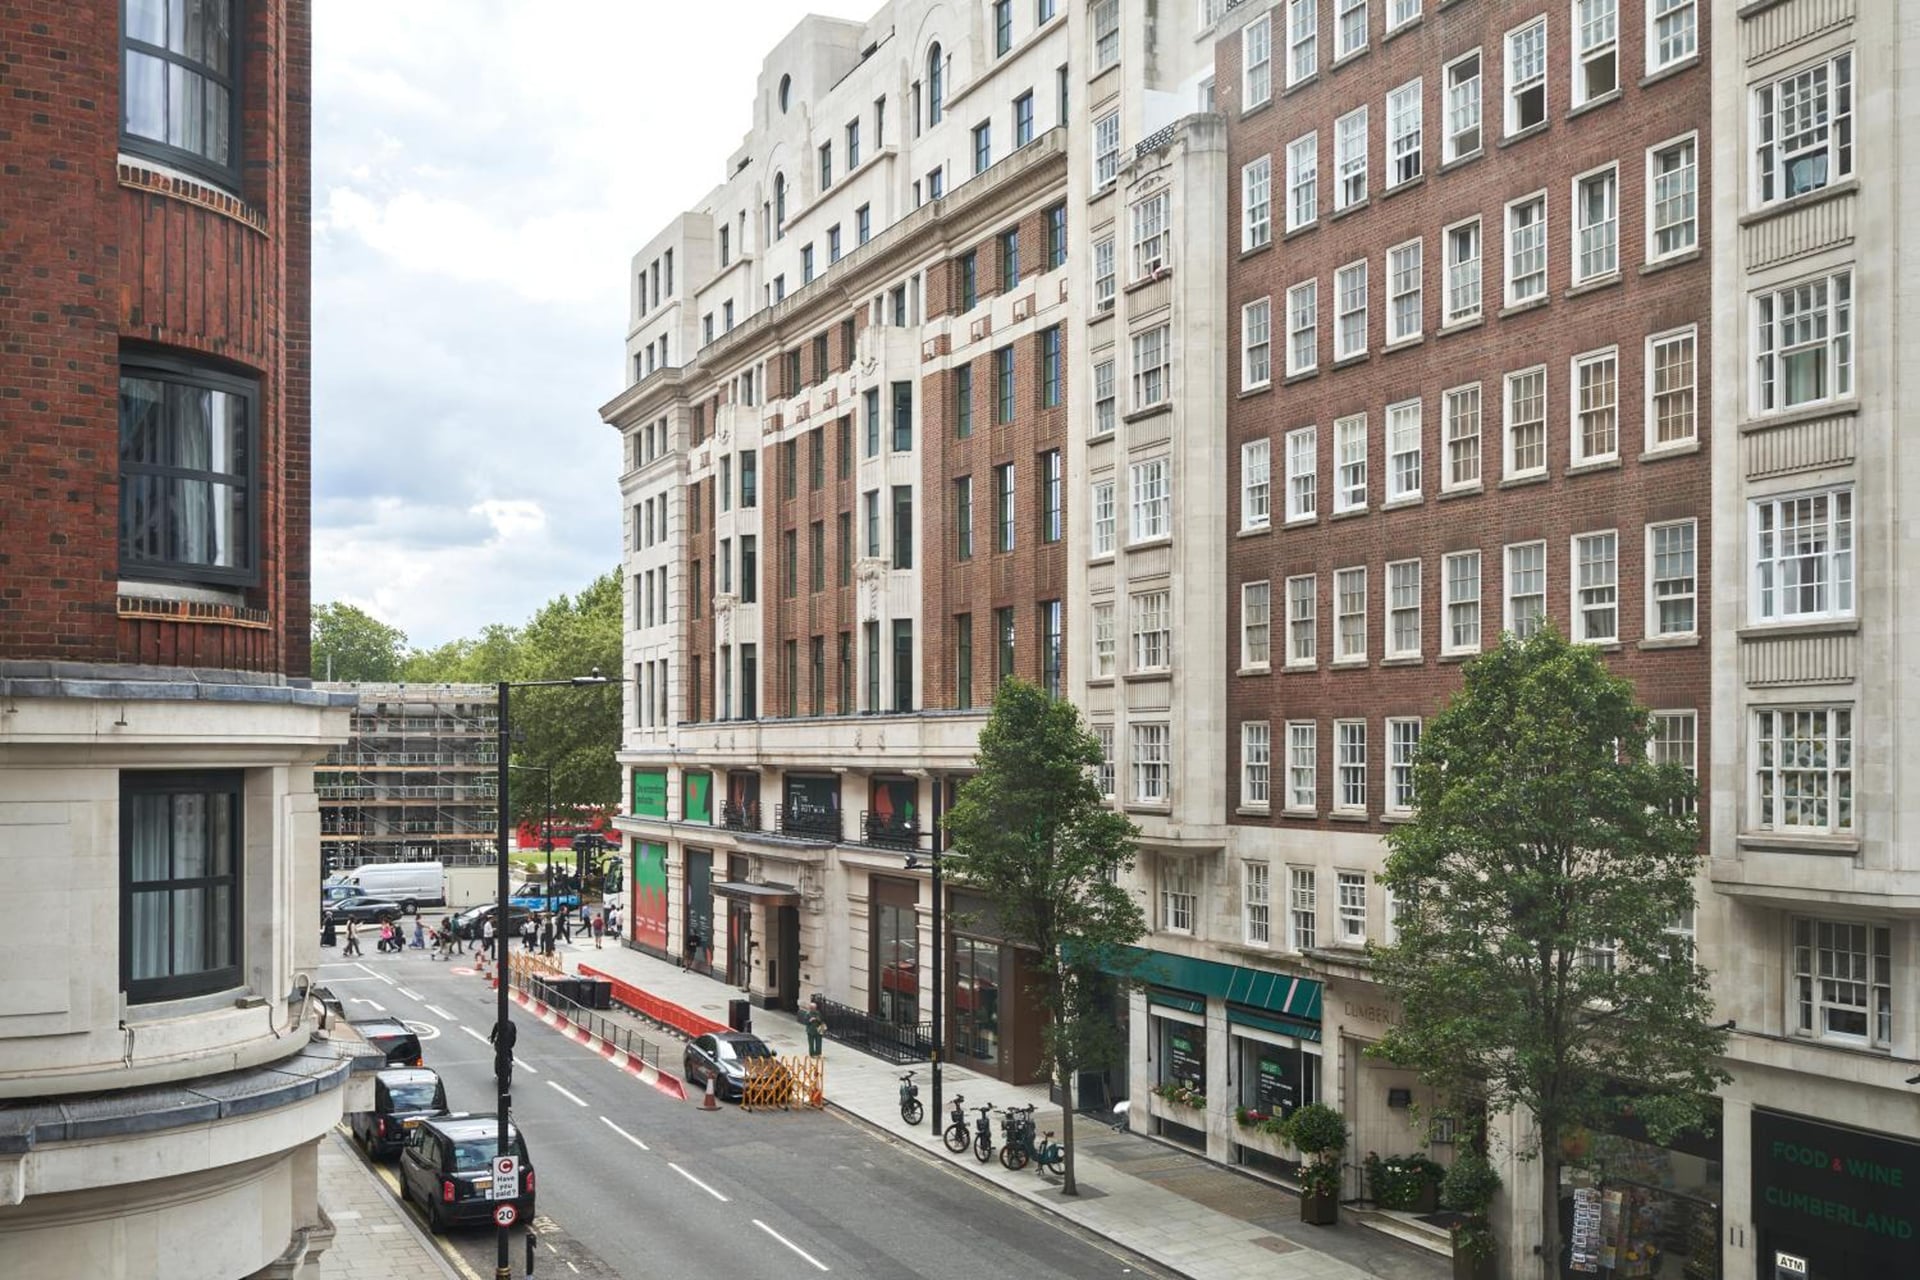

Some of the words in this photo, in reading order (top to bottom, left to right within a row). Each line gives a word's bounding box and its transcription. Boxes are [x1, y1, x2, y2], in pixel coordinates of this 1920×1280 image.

[1344, 1001, 1405, 1028] CUMBERL
[1772, 1140, 1829, 1169] FOOD
[1831, 1157, 1843, 1173] &
[1846, 1157, 1904, 1187] WINE
[497, 1175, 515, 1183] Have
[499, 1210, 514, 1221] 20
[1765, 1186, 1913, 1239] CUMBERLAND
[1780, 1256, 1803, 1272] ATM
